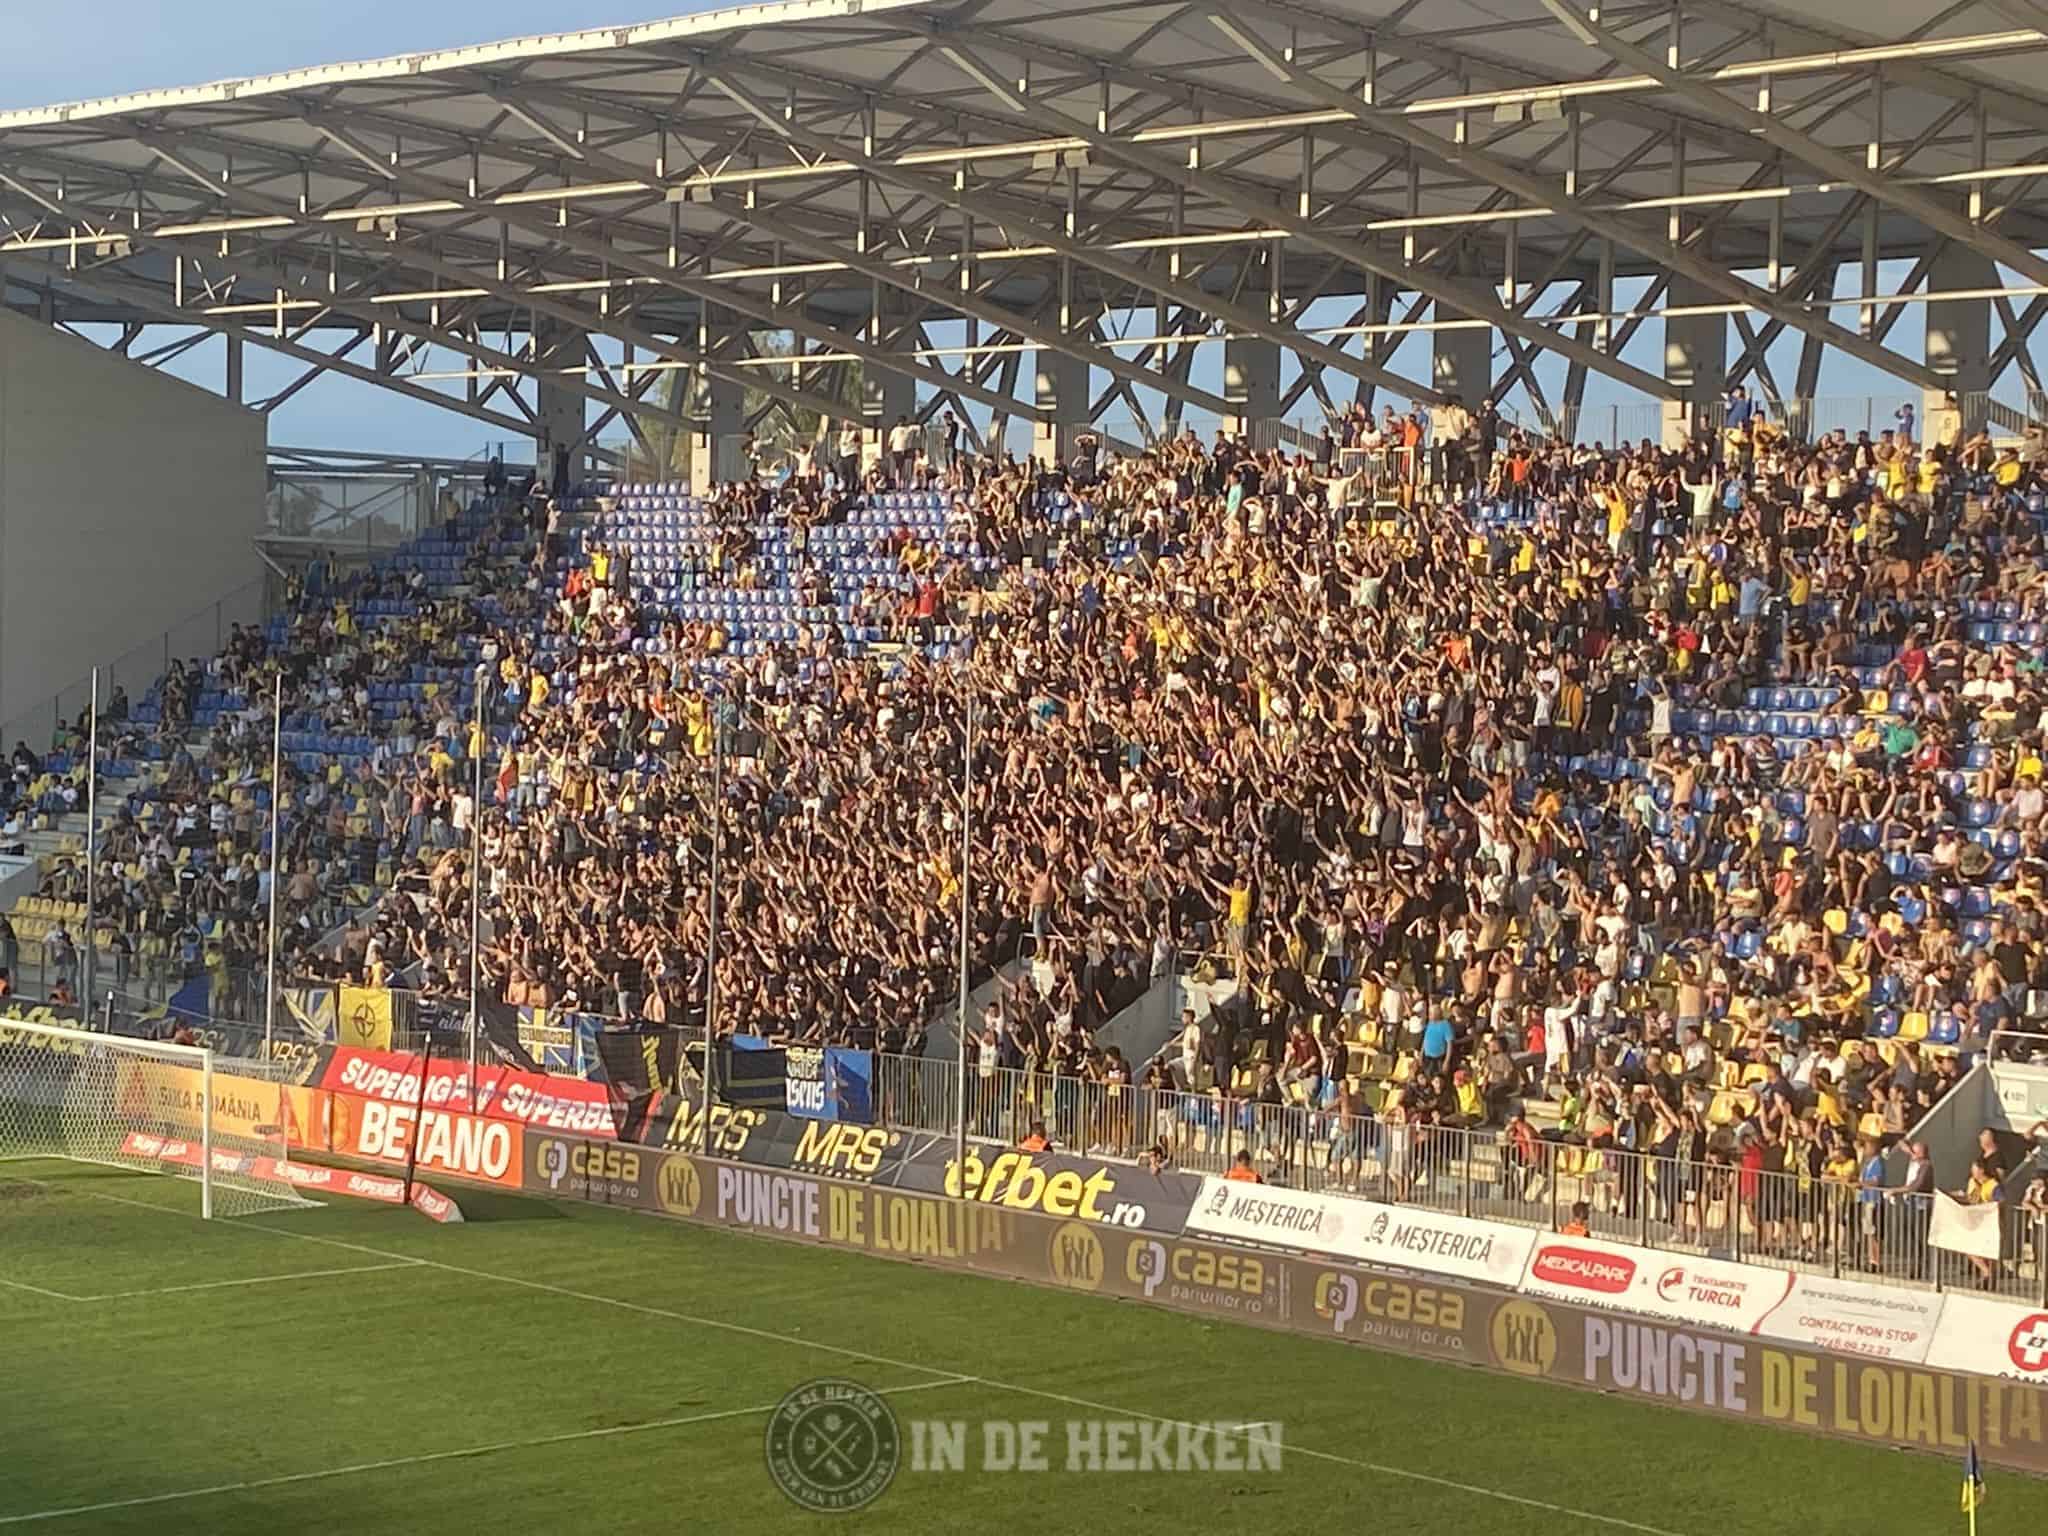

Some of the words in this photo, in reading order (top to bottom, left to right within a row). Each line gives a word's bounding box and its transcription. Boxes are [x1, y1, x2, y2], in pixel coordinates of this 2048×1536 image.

[195, 1090, 261, 1121] RMÂNIA
[503, 1083, 616, 1131] SUPERBE
[666, 1100, 756, 1151] MRS
[358, 1101, 510, 1179] BETANO
[572, 1144, 640, 1182] casa
[794, 1120, 888, 1172] MRS
[717, 1167, 820, 1236] PUNCTE
[829, 1186, 866, 1244] DE
[1172, 1246, 1264, 1295] casa
[1364, 1280, 1465, 1331] casa
[1688, 1287, 1743, 1309] TURCIA
[1799, 1315, 1855, 1335] CONTACT
[1855, 1324, 1883, 1339] NON
[1886, 1328, 1919, 1344] STOP
[1584, 1316, 1748, 1412] PUNCTE
[1761, 1349, 1820, 1426] DE
